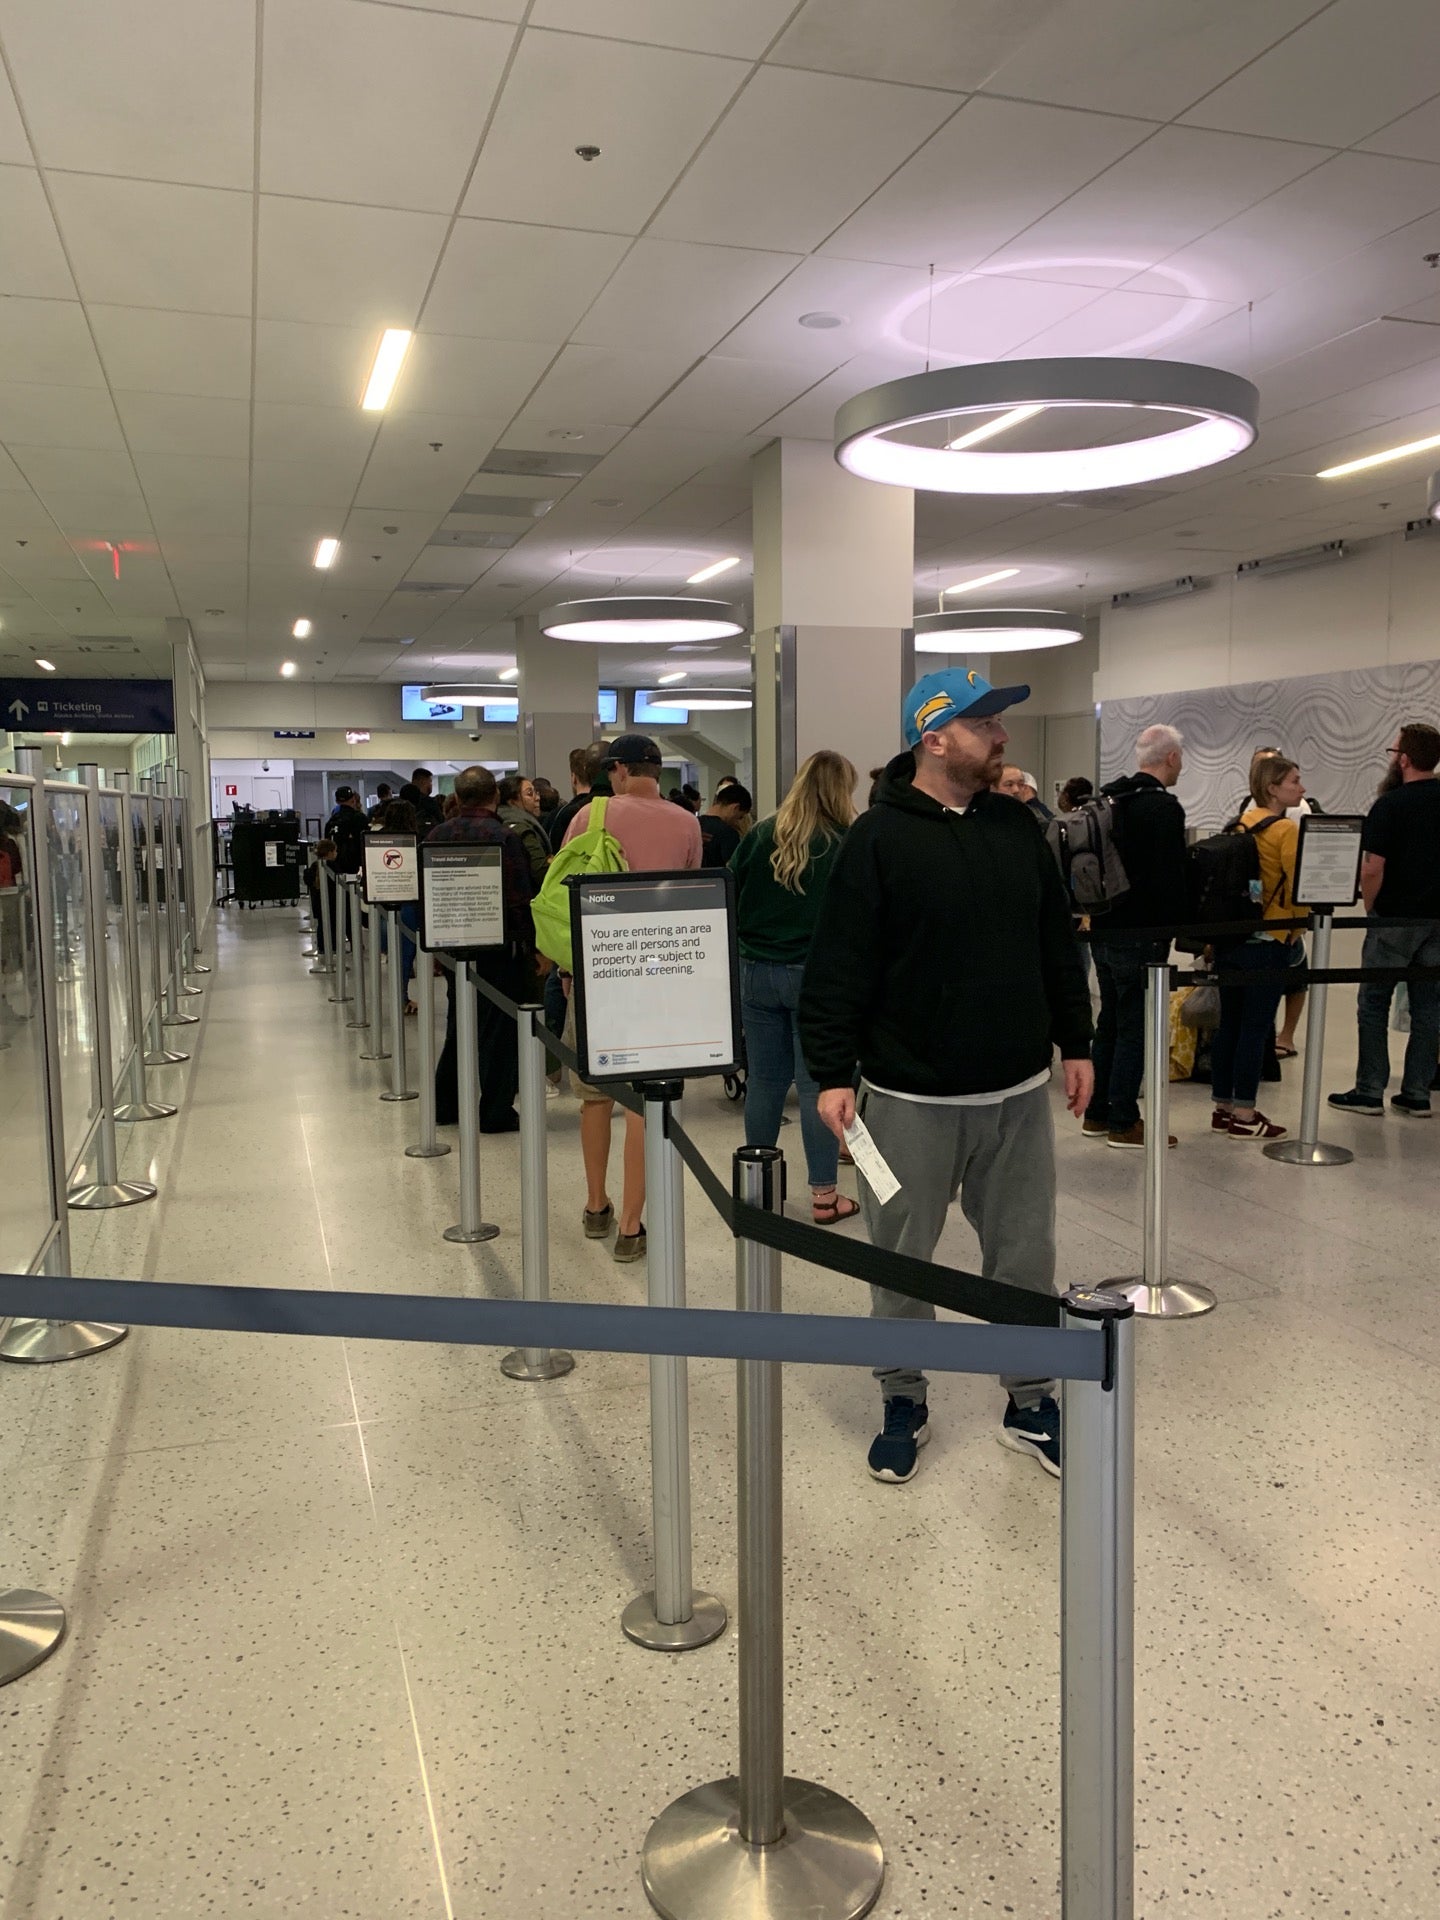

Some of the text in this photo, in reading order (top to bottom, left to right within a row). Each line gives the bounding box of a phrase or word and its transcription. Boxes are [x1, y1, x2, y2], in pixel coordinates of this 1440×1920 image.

[52, 702, 102, 713] Ticketing
[588, 894, 616, 903] Notice
[590, 924, 712, 939] You are entering an area
[592, 937, 700, 952] where all persons and
[592, 955, 637, 967] property
[658, 951, 693, 963] subject
[695, 950, 706, 960] to
[592, 964, 695, 979] additional screening.
